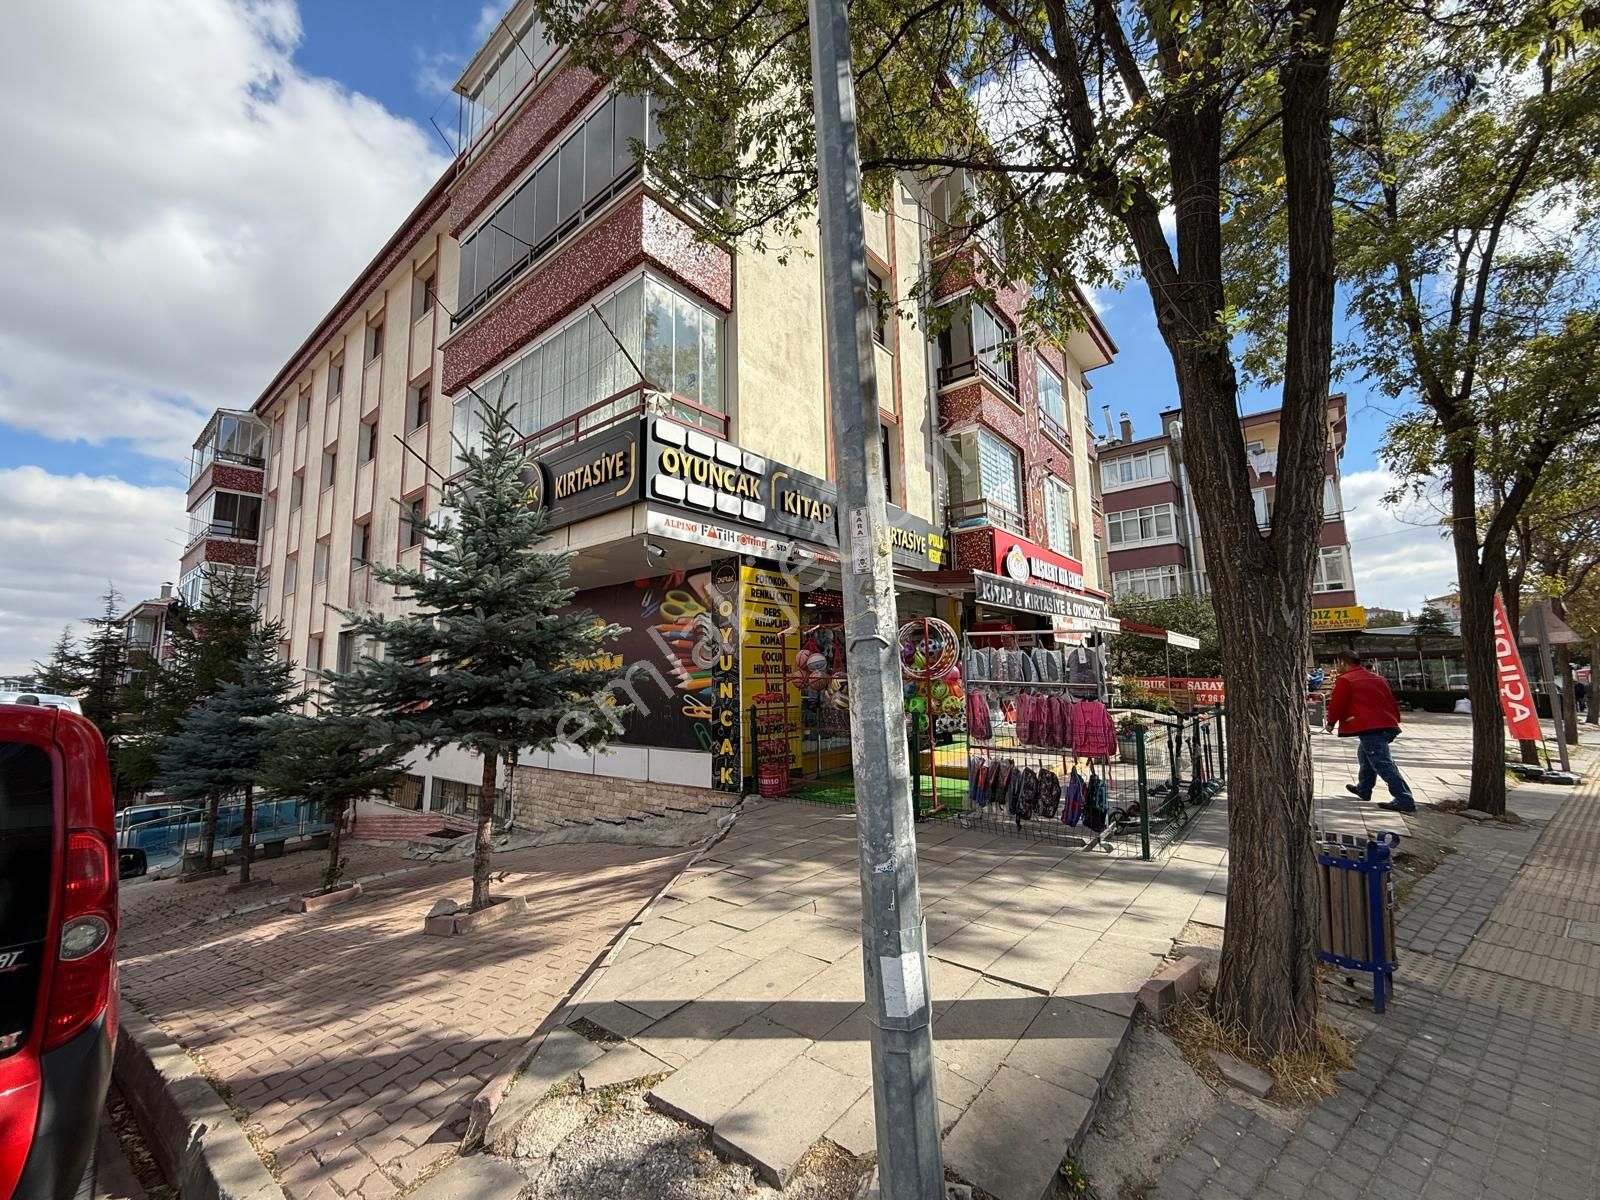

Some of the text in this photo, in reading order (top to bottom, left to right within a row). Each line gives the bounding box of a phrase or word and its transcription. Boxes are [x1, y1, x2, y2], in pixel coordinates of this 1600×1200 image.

[555, 451, 625, 500] KIRTASİYE
[662, 447, 761, 501] OYUNCAK
[784, 489, 833, 523] KİTAP
[664, 517, 698, 534] ALPINO
[764, 607, 782, 617] DERS
[982, 580, 1013, 605] KİTAP
[1015, 590, 1023, 607] &
[1024, 592, 1066, 615] KIRTASİYE
[1066, 601, 1073, 616] &
[1334, 609, 1349, 619] 71
[760, 635, 784, 646] ROMA
[719, 601, 736, 785] OYUNCAK
